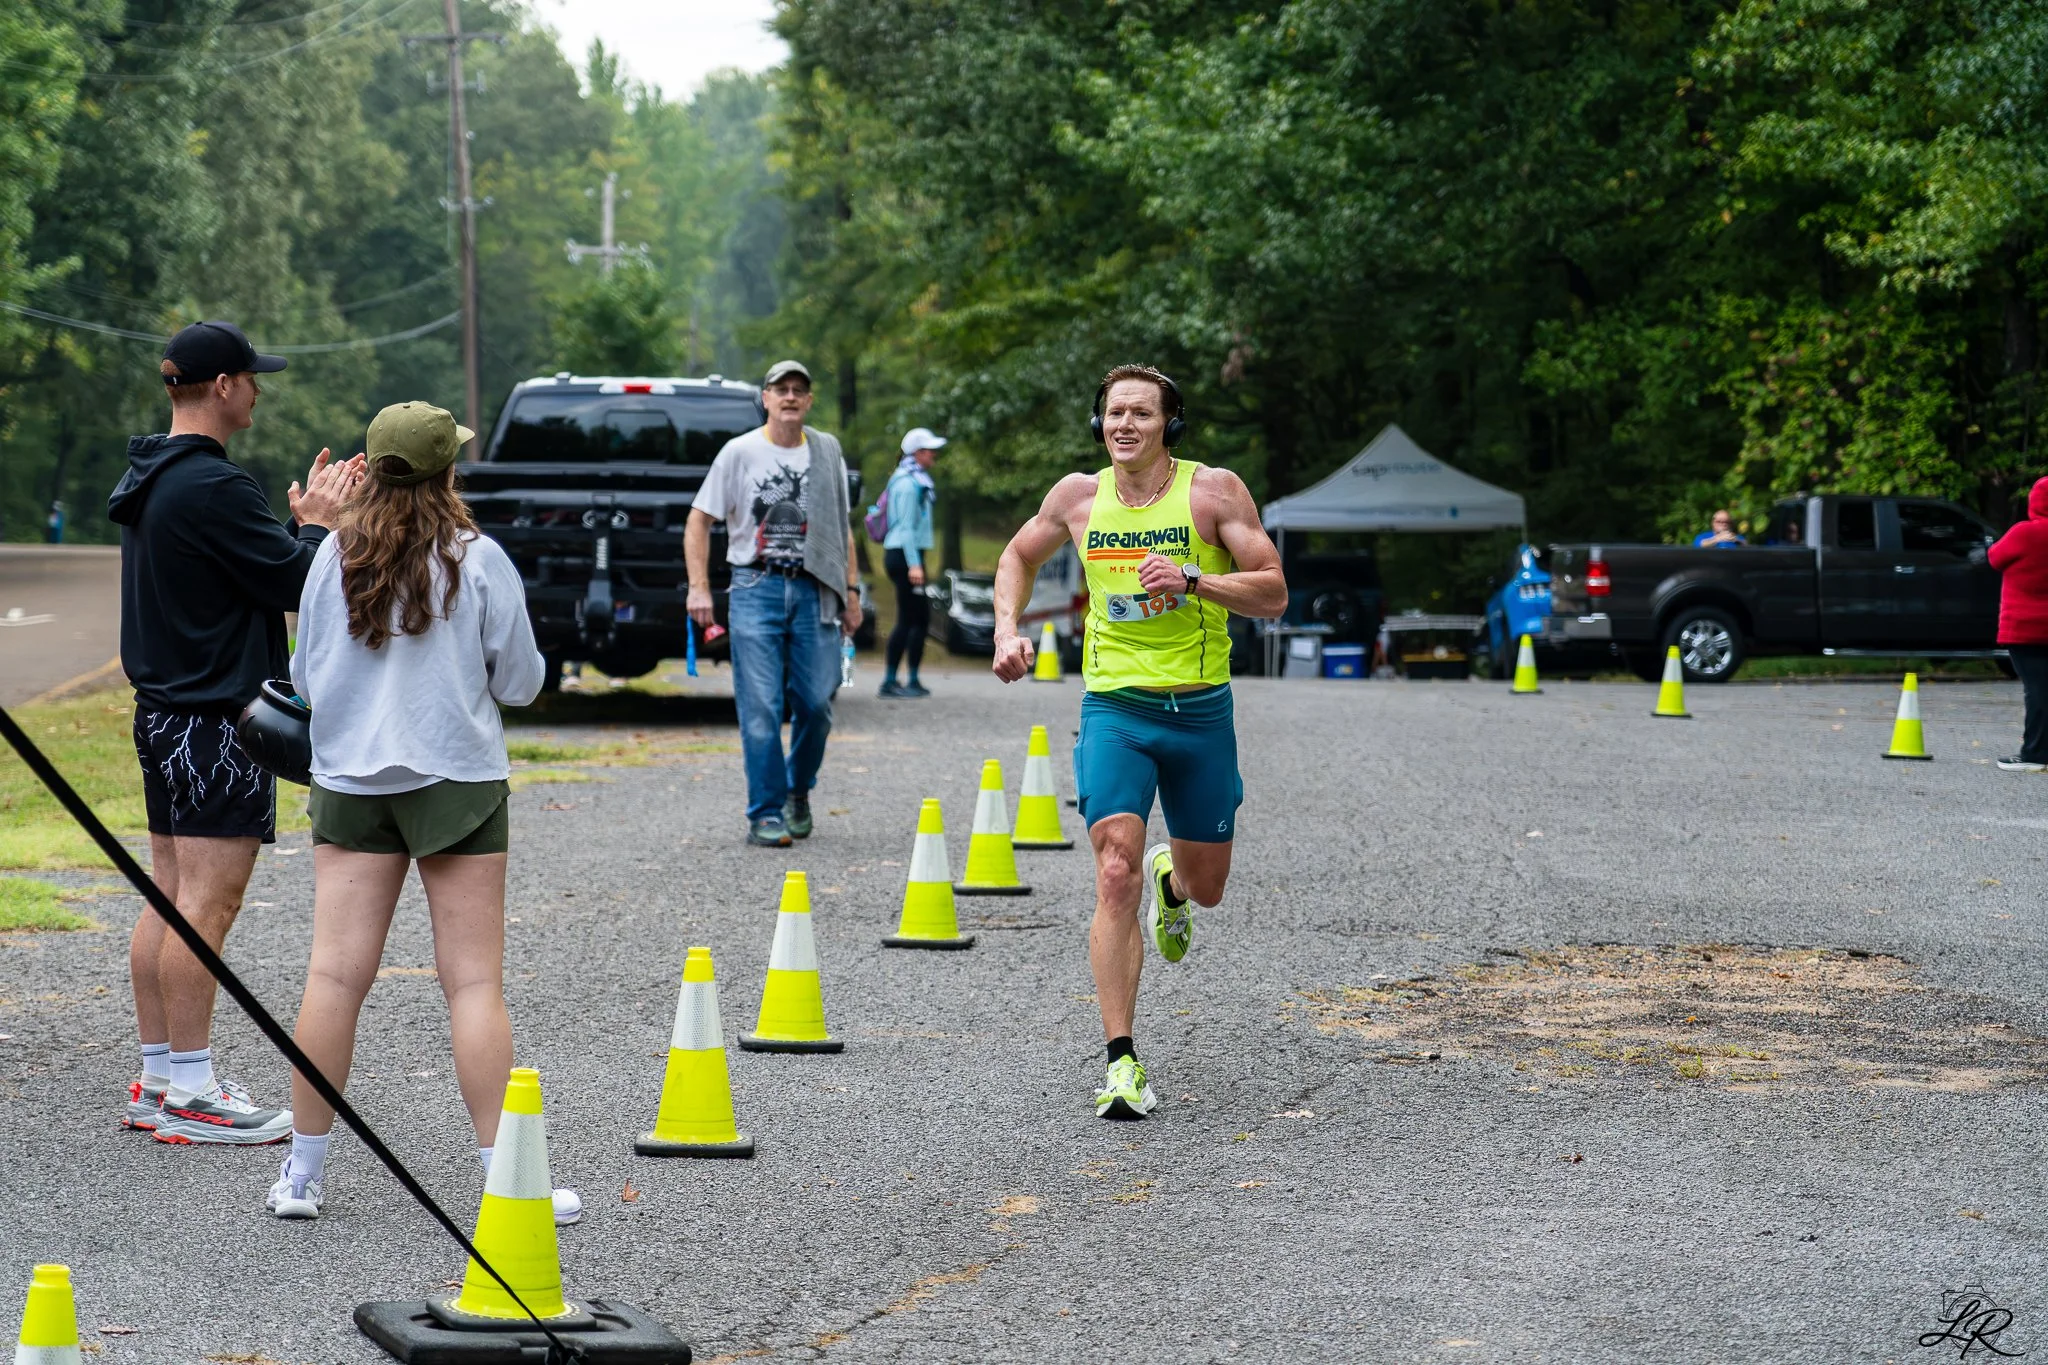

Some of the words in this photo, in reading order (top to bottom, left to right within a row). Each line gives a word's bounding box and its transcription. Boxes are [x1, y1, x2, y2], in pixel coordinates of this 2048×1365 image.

[1088, 526, 1189, 549] Breakaway
[1149, 543, 1192, 558] Running
[1138, 592, 1179, 618] 195
[169, 1109, 235, 1126] ALTRA
